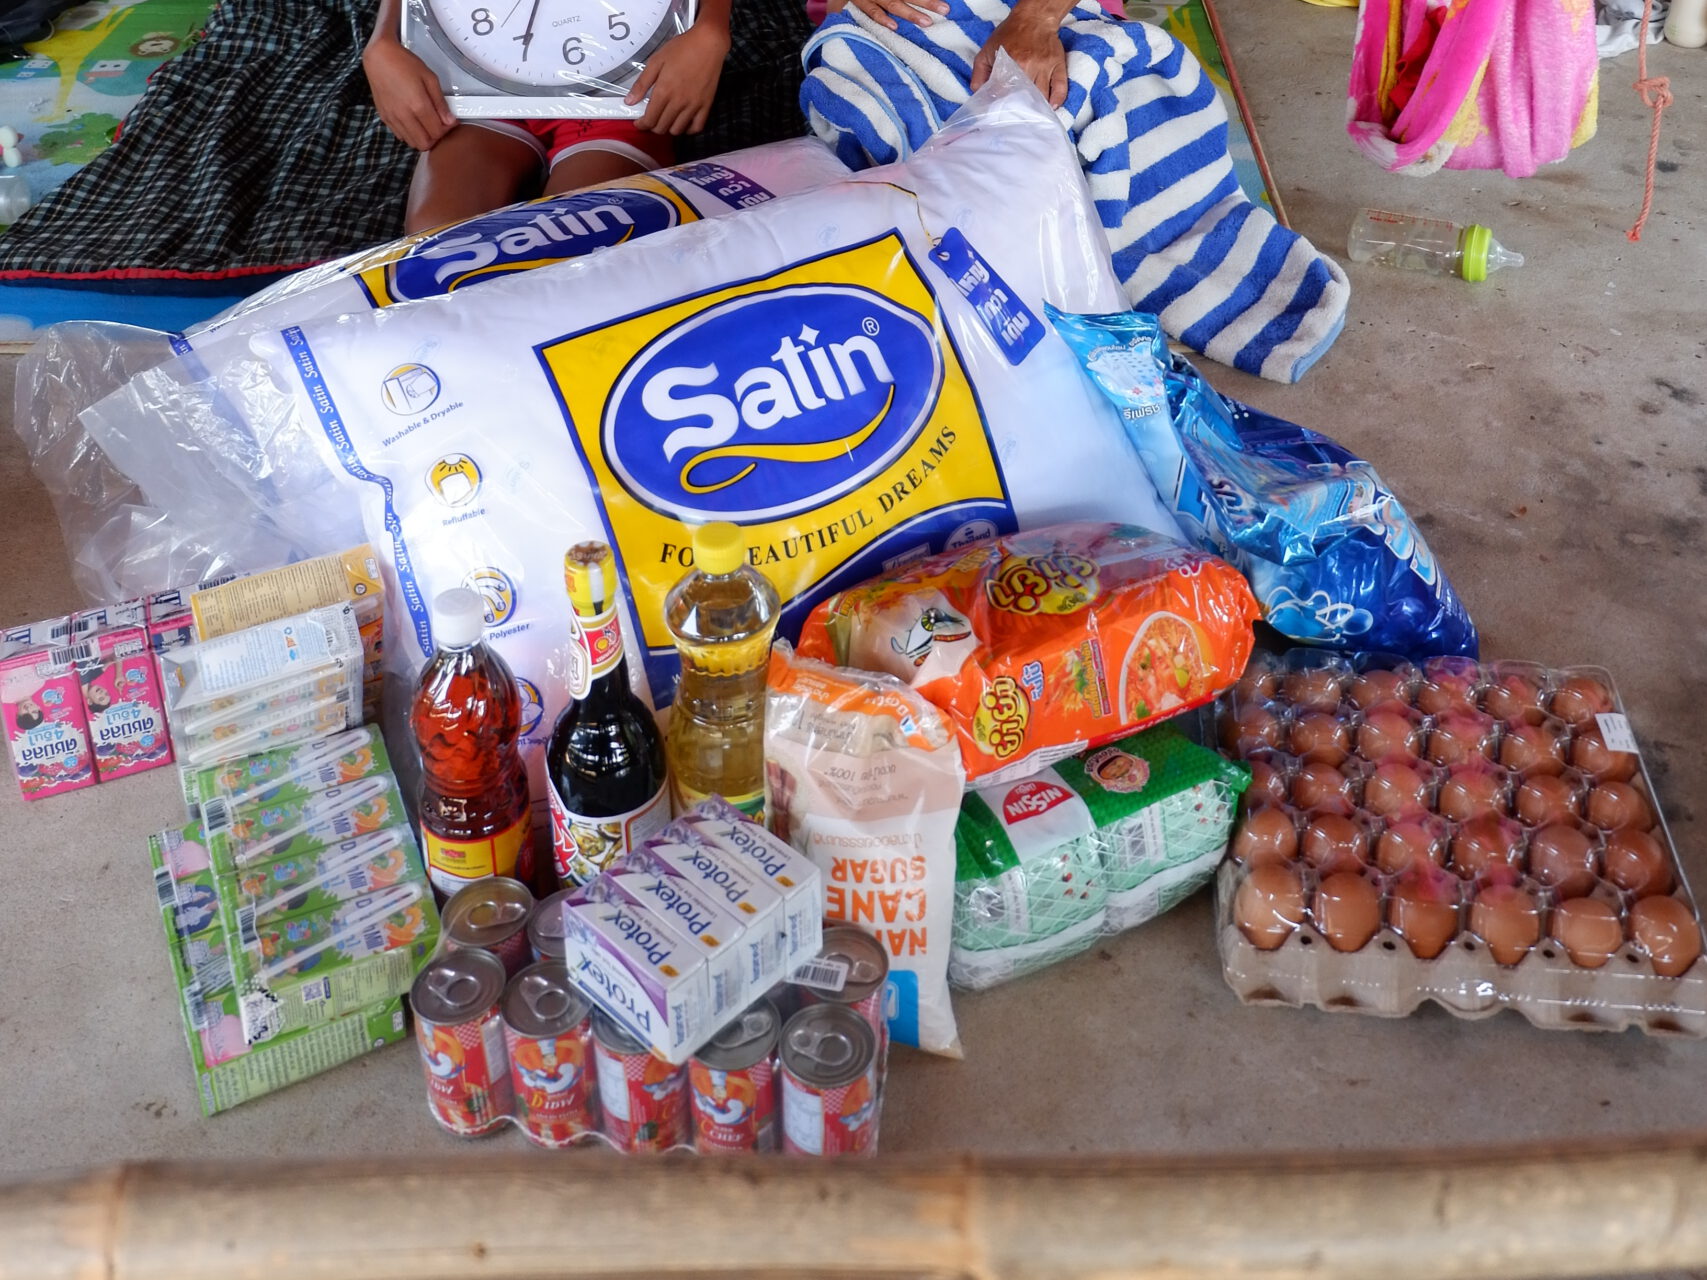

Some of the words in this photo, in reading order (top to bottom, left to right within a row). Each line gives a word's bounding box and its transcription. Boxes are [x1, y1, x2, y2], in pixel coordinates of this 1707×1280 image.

[471, 8, 495, 36] 8
[552, 15, 581, 28] QUARTZ
[607, 12, 631, 41] 5
[513, 32, 534, 62] 7
[562, 37, 586, 65] 6
[420, 202, 635, 286] Satin
[298, 350, 318, 379] Satin
[313, 384, 334, 414] Satin
[641, 323, 895, 464] Satin
[328, 419, 350, 450] Satin
[382, 421, 422, 447] Washable
[422, 417, 430, 425] &
[430, 401, 464, 421] Dryable
[749, 509, 874, 567] EAUTIFUL
[876, 424, 957, 514] DREAMS
[394, 541, 411, 573] Satin
[405, 580, 424, 613] Satin
[420, 620, 433, 656] Satin
[489, 623, 530, 641] Polyester
[99, 715, 154, 744] ดัชมิลล์
[980, 676, 1024, 760] ยำยำ
[21, 737, 78, 764] ดัชมิลล์
[1006, 787, 1063, 817] NISSIN
[724, 825, 787, 877] Protex
[685, 850, 750, 904] Protex
[830, 855, 928, 883] SUGAR
[647, 879, 713, 936] Protex
[825, 885, 928, 922] CANE
[604, 910, 672, 966] Protex
[578, 951, 651, 1032] Protex
[709, 1130, 744, 1144] CHEF
